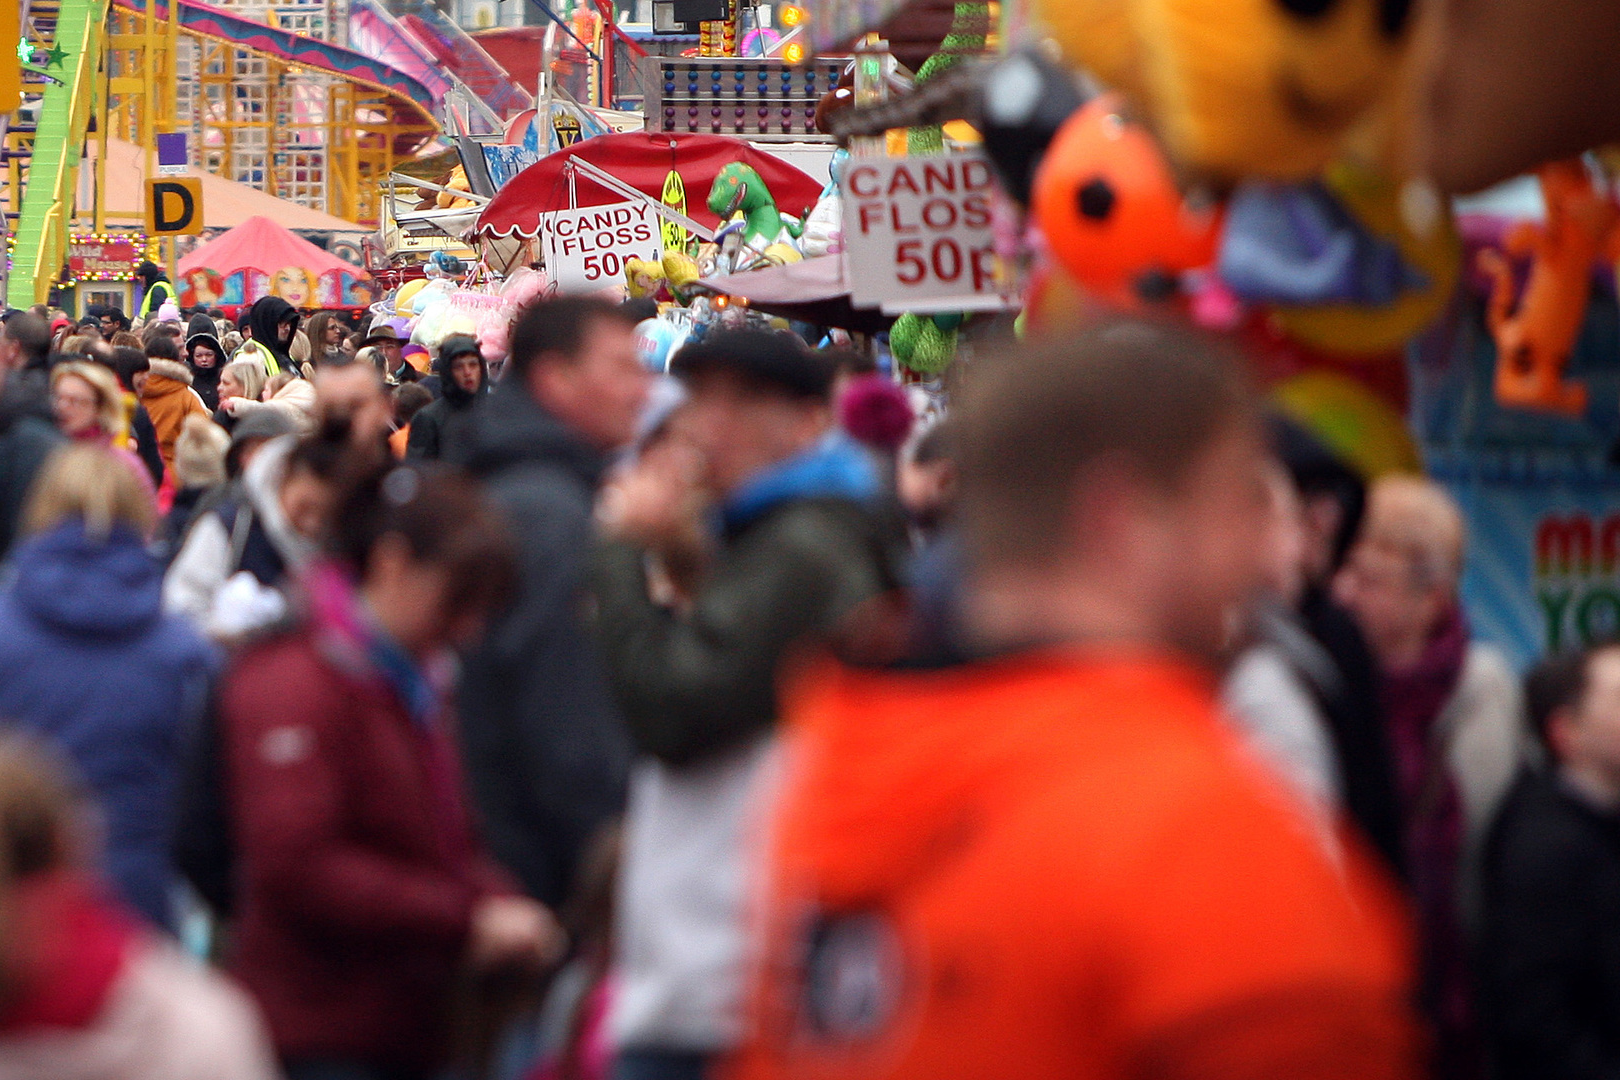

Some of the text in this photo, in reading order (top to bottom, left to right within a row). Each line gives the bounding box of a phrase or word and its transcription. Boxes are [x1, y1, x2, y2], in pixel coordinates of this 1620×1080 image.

[849, 160, 993, 199] CAND
[153, 183, 194, 231] D
[555, 204, 649, 237] CANDY
[859, 196, 993, 236] FLOS
[562, 224, 651, 256] FLOSS
